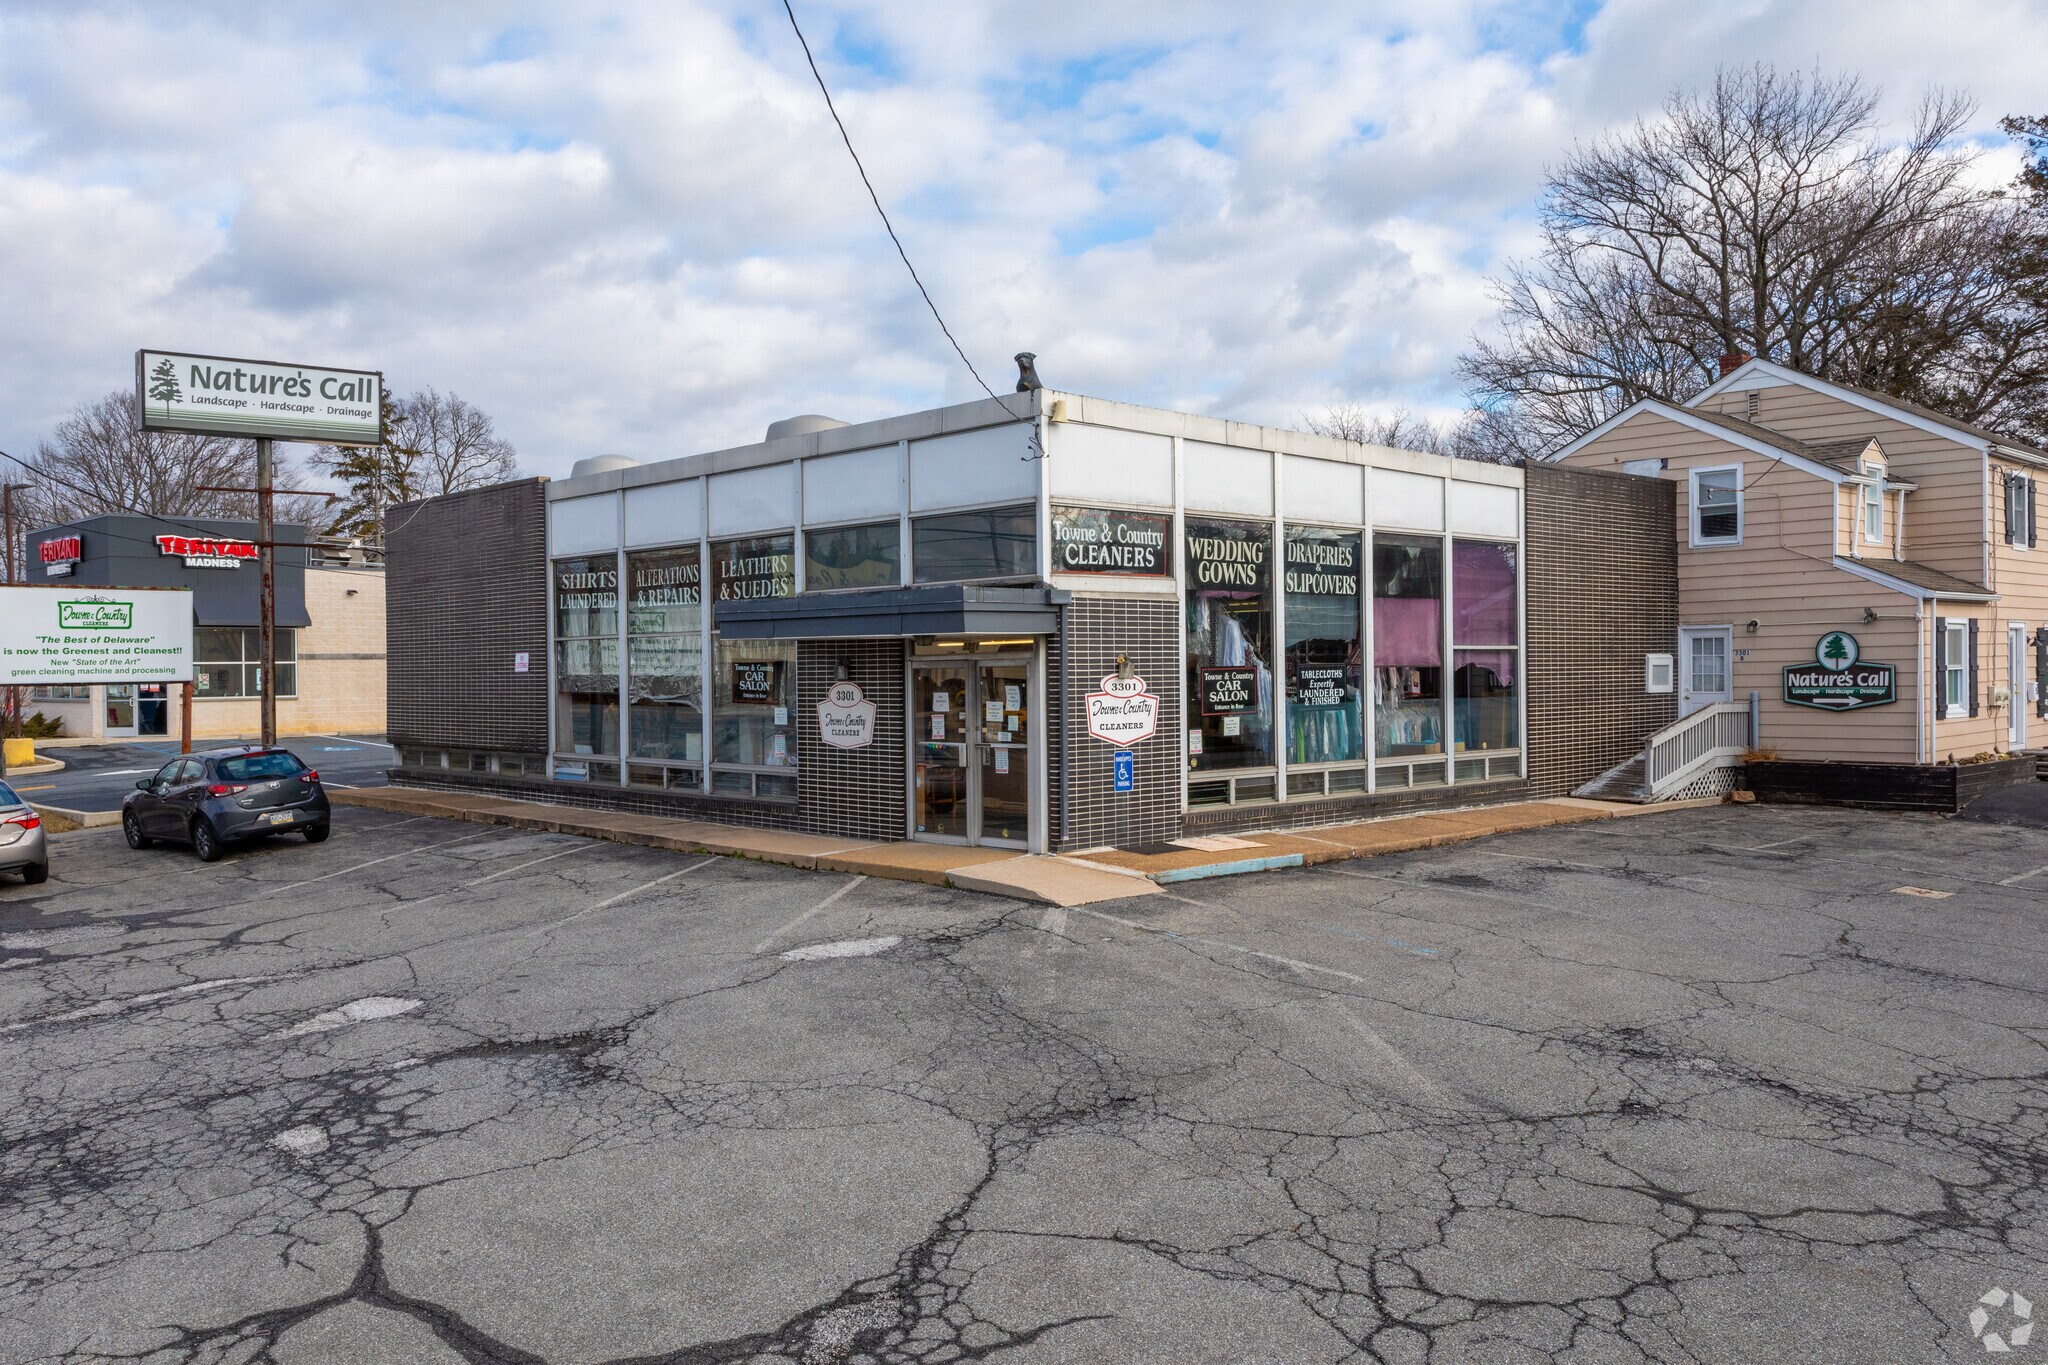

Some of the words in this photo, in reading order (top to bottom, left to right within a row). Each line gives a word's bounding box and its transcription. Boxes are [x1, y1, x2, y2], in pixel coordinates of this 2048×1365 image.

[190, 365, 311, 398] Nature's
[320, 378, 372, 403] Call
[191, 395, 247, 409] Landscape
[260, 401, 314, 414] Hardscape
[327, 406, 372, 419] Drainage
[1053, 520, 1096, 542] Towne
[1101, 523, 1112, 543] &
[1118, 524, 1163, 549] Country
[38, 538, 79, 562] TERIYAKI
[159, 536, 258, 558] TERIYAK
[1065, 543, 1154, 567] CLEANERS
[1188, 537, 1263, 564] WEDDING
[1288, 542, 1352, 567] DRAPERIES
[186, 558, 240, 568] MADNESS
[721, 555, 787, 578] LEATHERS
[1316, 563, 1322, 572] &
[562, 571, 617, 589] SHIRTS
[636, 564, 699, 587] ALTERATIONS
[1199, 561, 1257, 585] GOWNS
[720, 583, 730, 600] &
[733, 578, 788, 600] SUEDES
[1286, 572, 1356, 596] SLIPCOVERS
[560, 592, 616, 609] LAUNDERED
[637, 590, 647, 608] &
[649, 587, 699, 606] REPAIRS
[64, 606, 91, 620] Towne
[96, 607, 128, 624] Country
[745, 672, 764, 681] CAR
[1232, 672, 1254, 680] Country
[1301, 670, 1342, 679] TABLECLOTHS
[1788, 671, 1854, 686] Nature's
[1857, 671, 1889, 686] Call
[739, 681, 770, 691] SALON
[1111, 683, 1137, 691] 3301
[1216, 680, 1241, 691] CAR
[1310, 679, 1334, 689] Expertly
[836, 691, 854, 701] 3301
[1210, 690, 1248, 702] SALON
[1300, 689, 1344, 698] LAUNDERED
[1312, 697, 1340, 705] FINISHED
[1092, 700, 1118, 716] Towne
[1123, 699, 1152, 717] Country
[825, 713, 842, 726] Towne
[845, 714, 866, 730] Country
